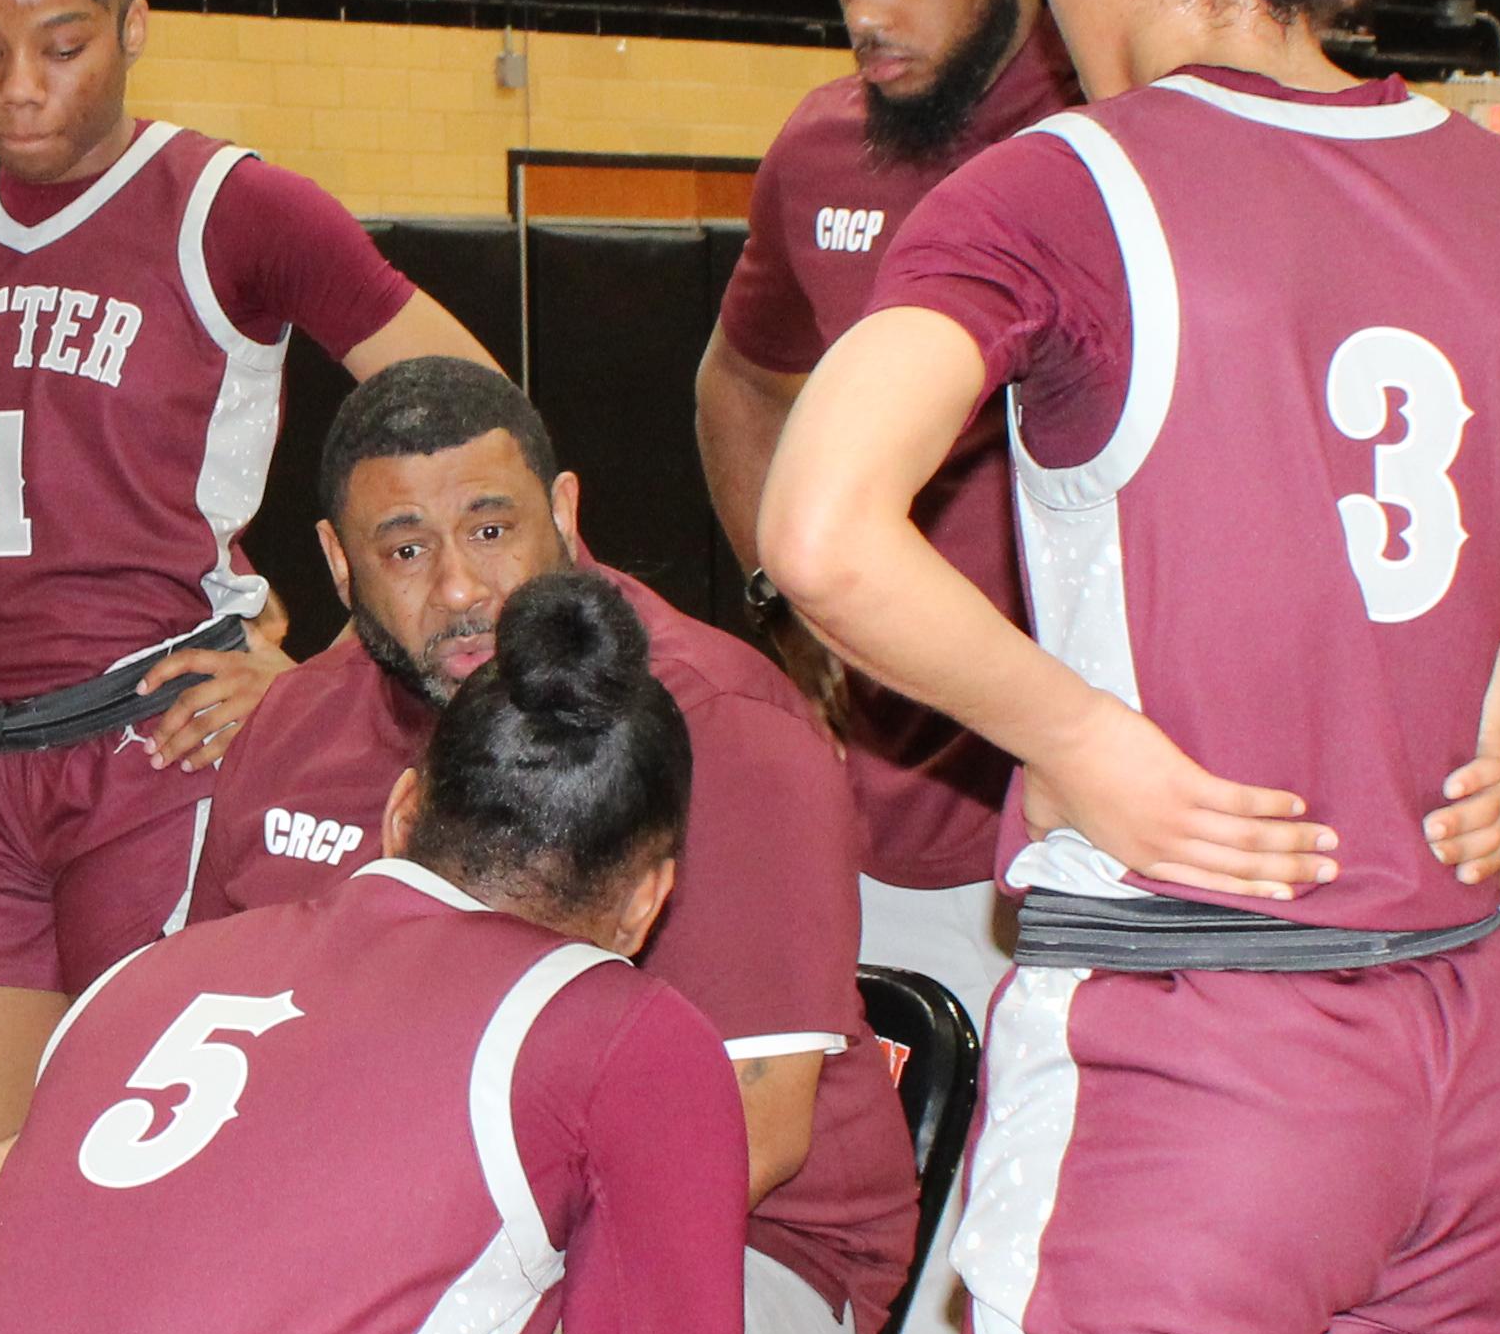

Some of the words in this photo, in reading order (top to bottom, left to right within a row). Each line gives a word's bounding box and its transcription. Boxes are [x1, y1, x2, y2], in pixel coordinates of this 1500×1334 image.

[815, 206, 885, 252] CRCP
[1325, 325, 1476, 624] 3
[263, 807, 365, 867] CRCP
[77, 988, 306, 1189] 5
